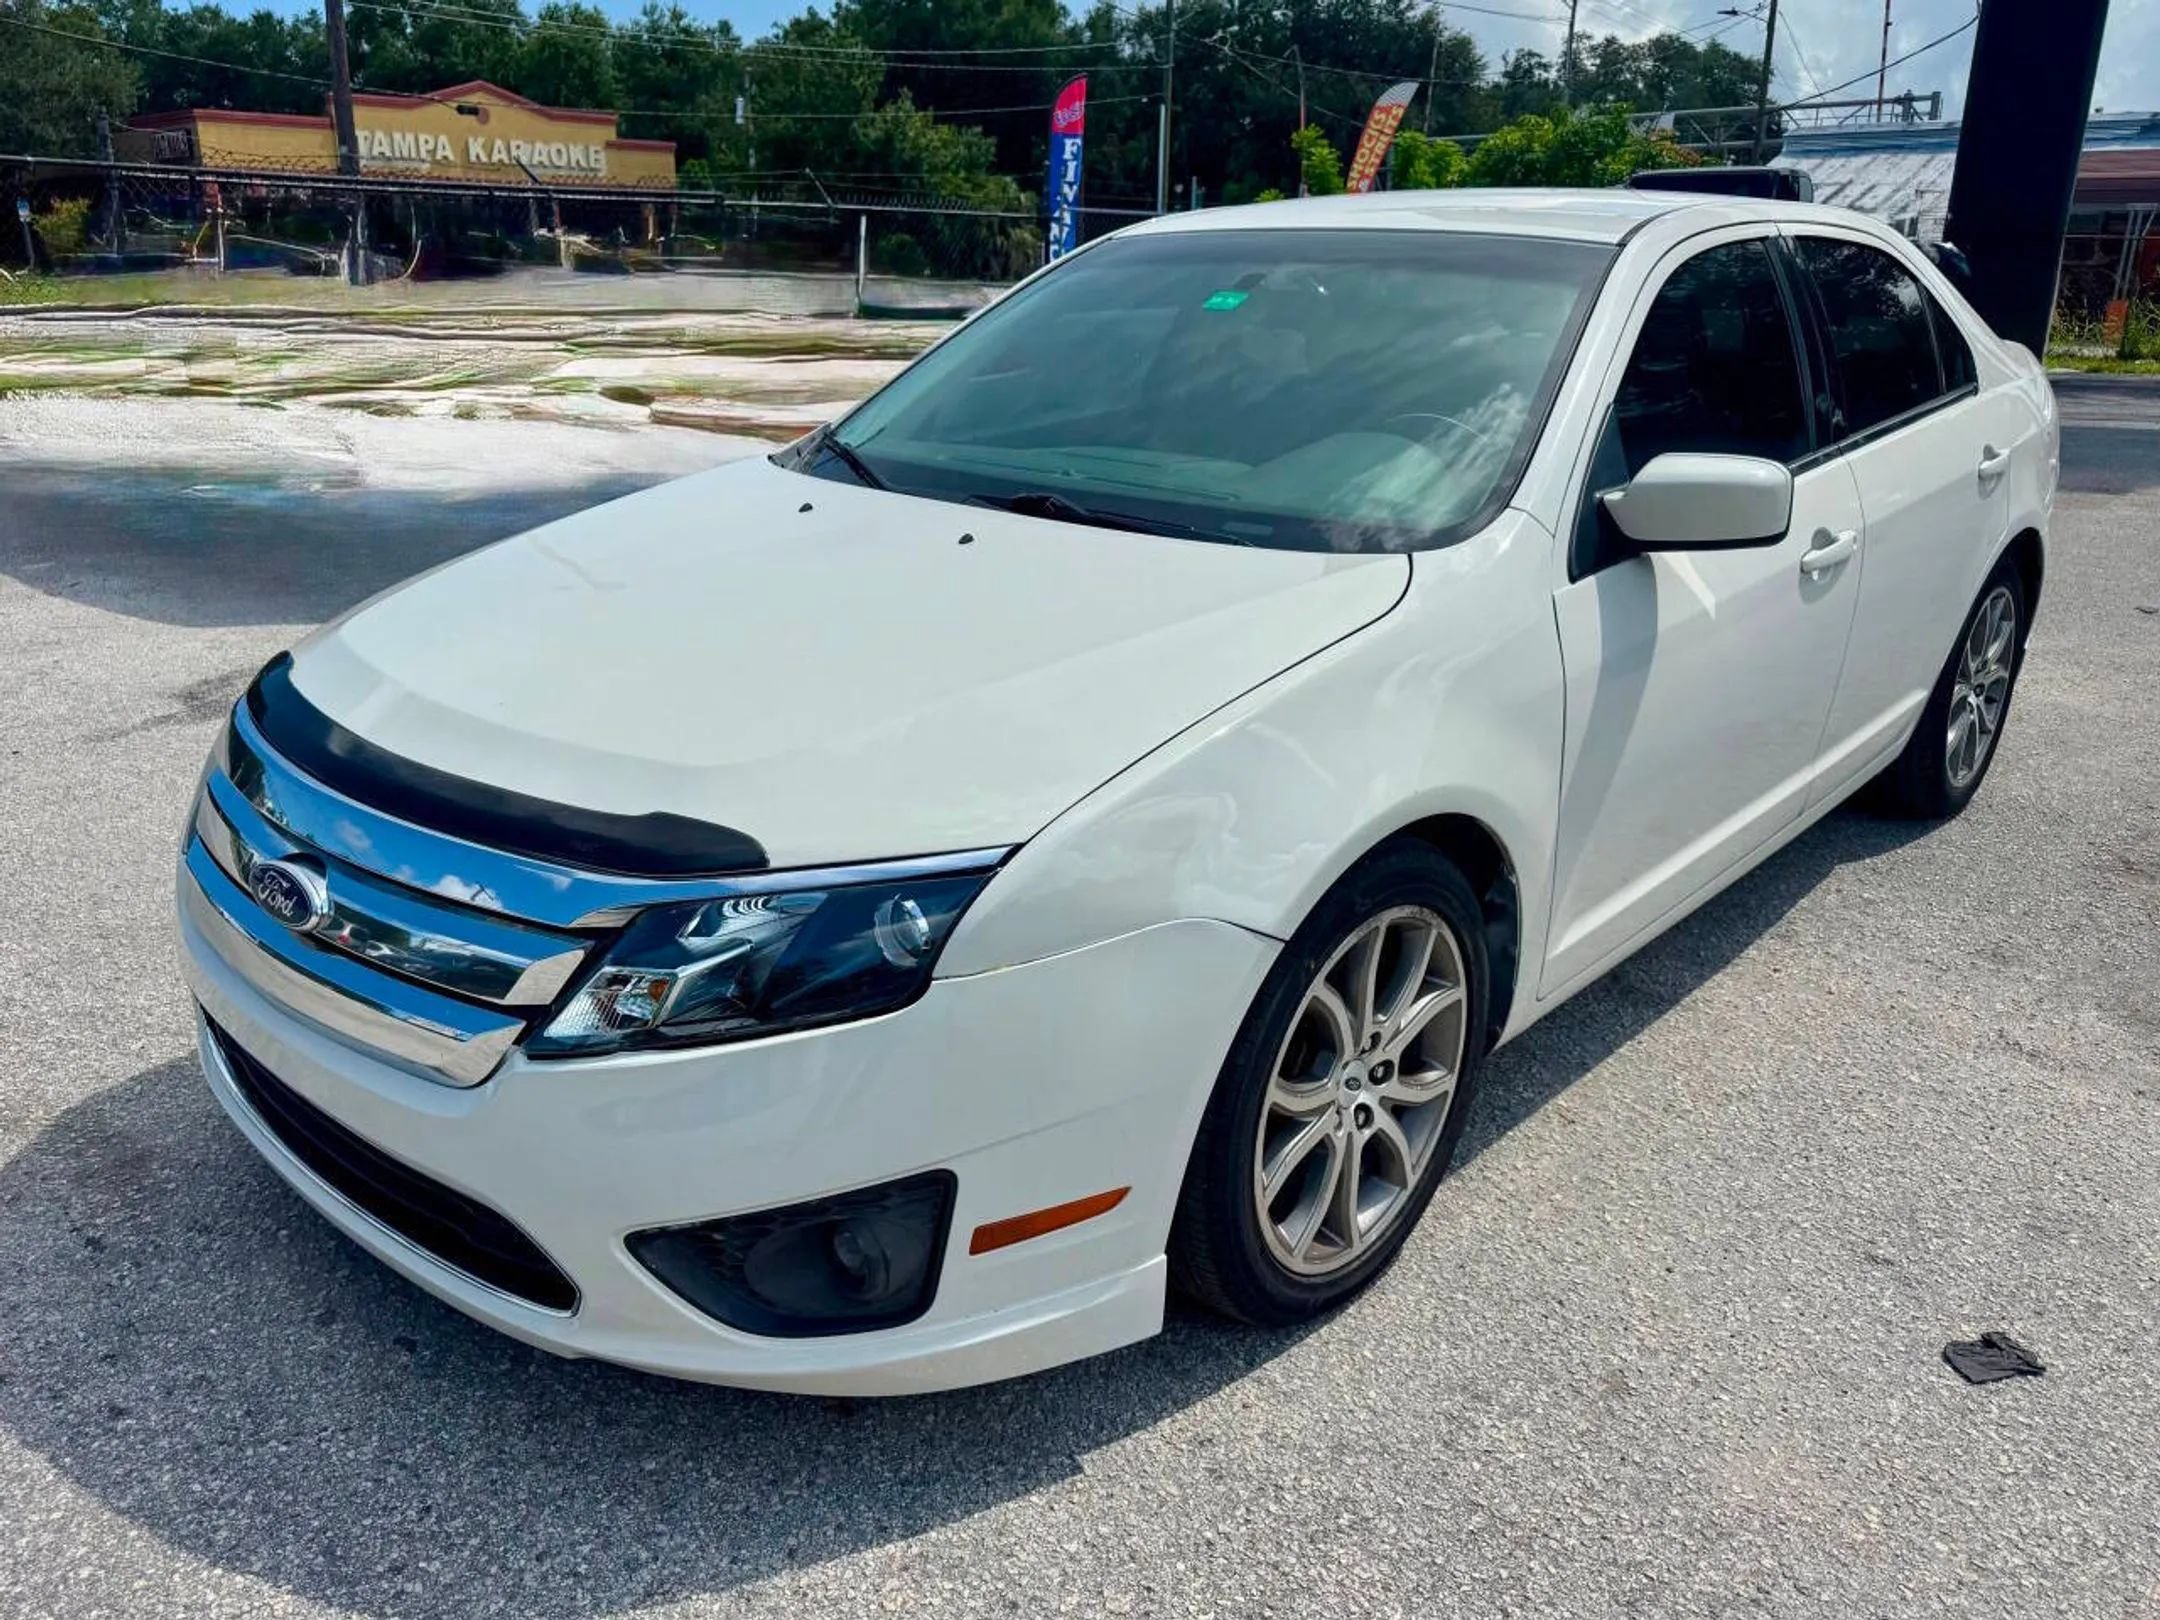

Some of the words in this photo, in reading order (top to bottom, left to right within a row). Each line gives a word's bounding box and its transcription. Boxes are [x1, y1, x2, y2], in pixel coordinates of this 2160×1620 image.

[355, 129, 456, 162] TAMPA
[467, 136, 606, 168] KARAOKE
[1346, 109, 1386, 190] SHOCKS
[258, 870, 298, 917] Ford
